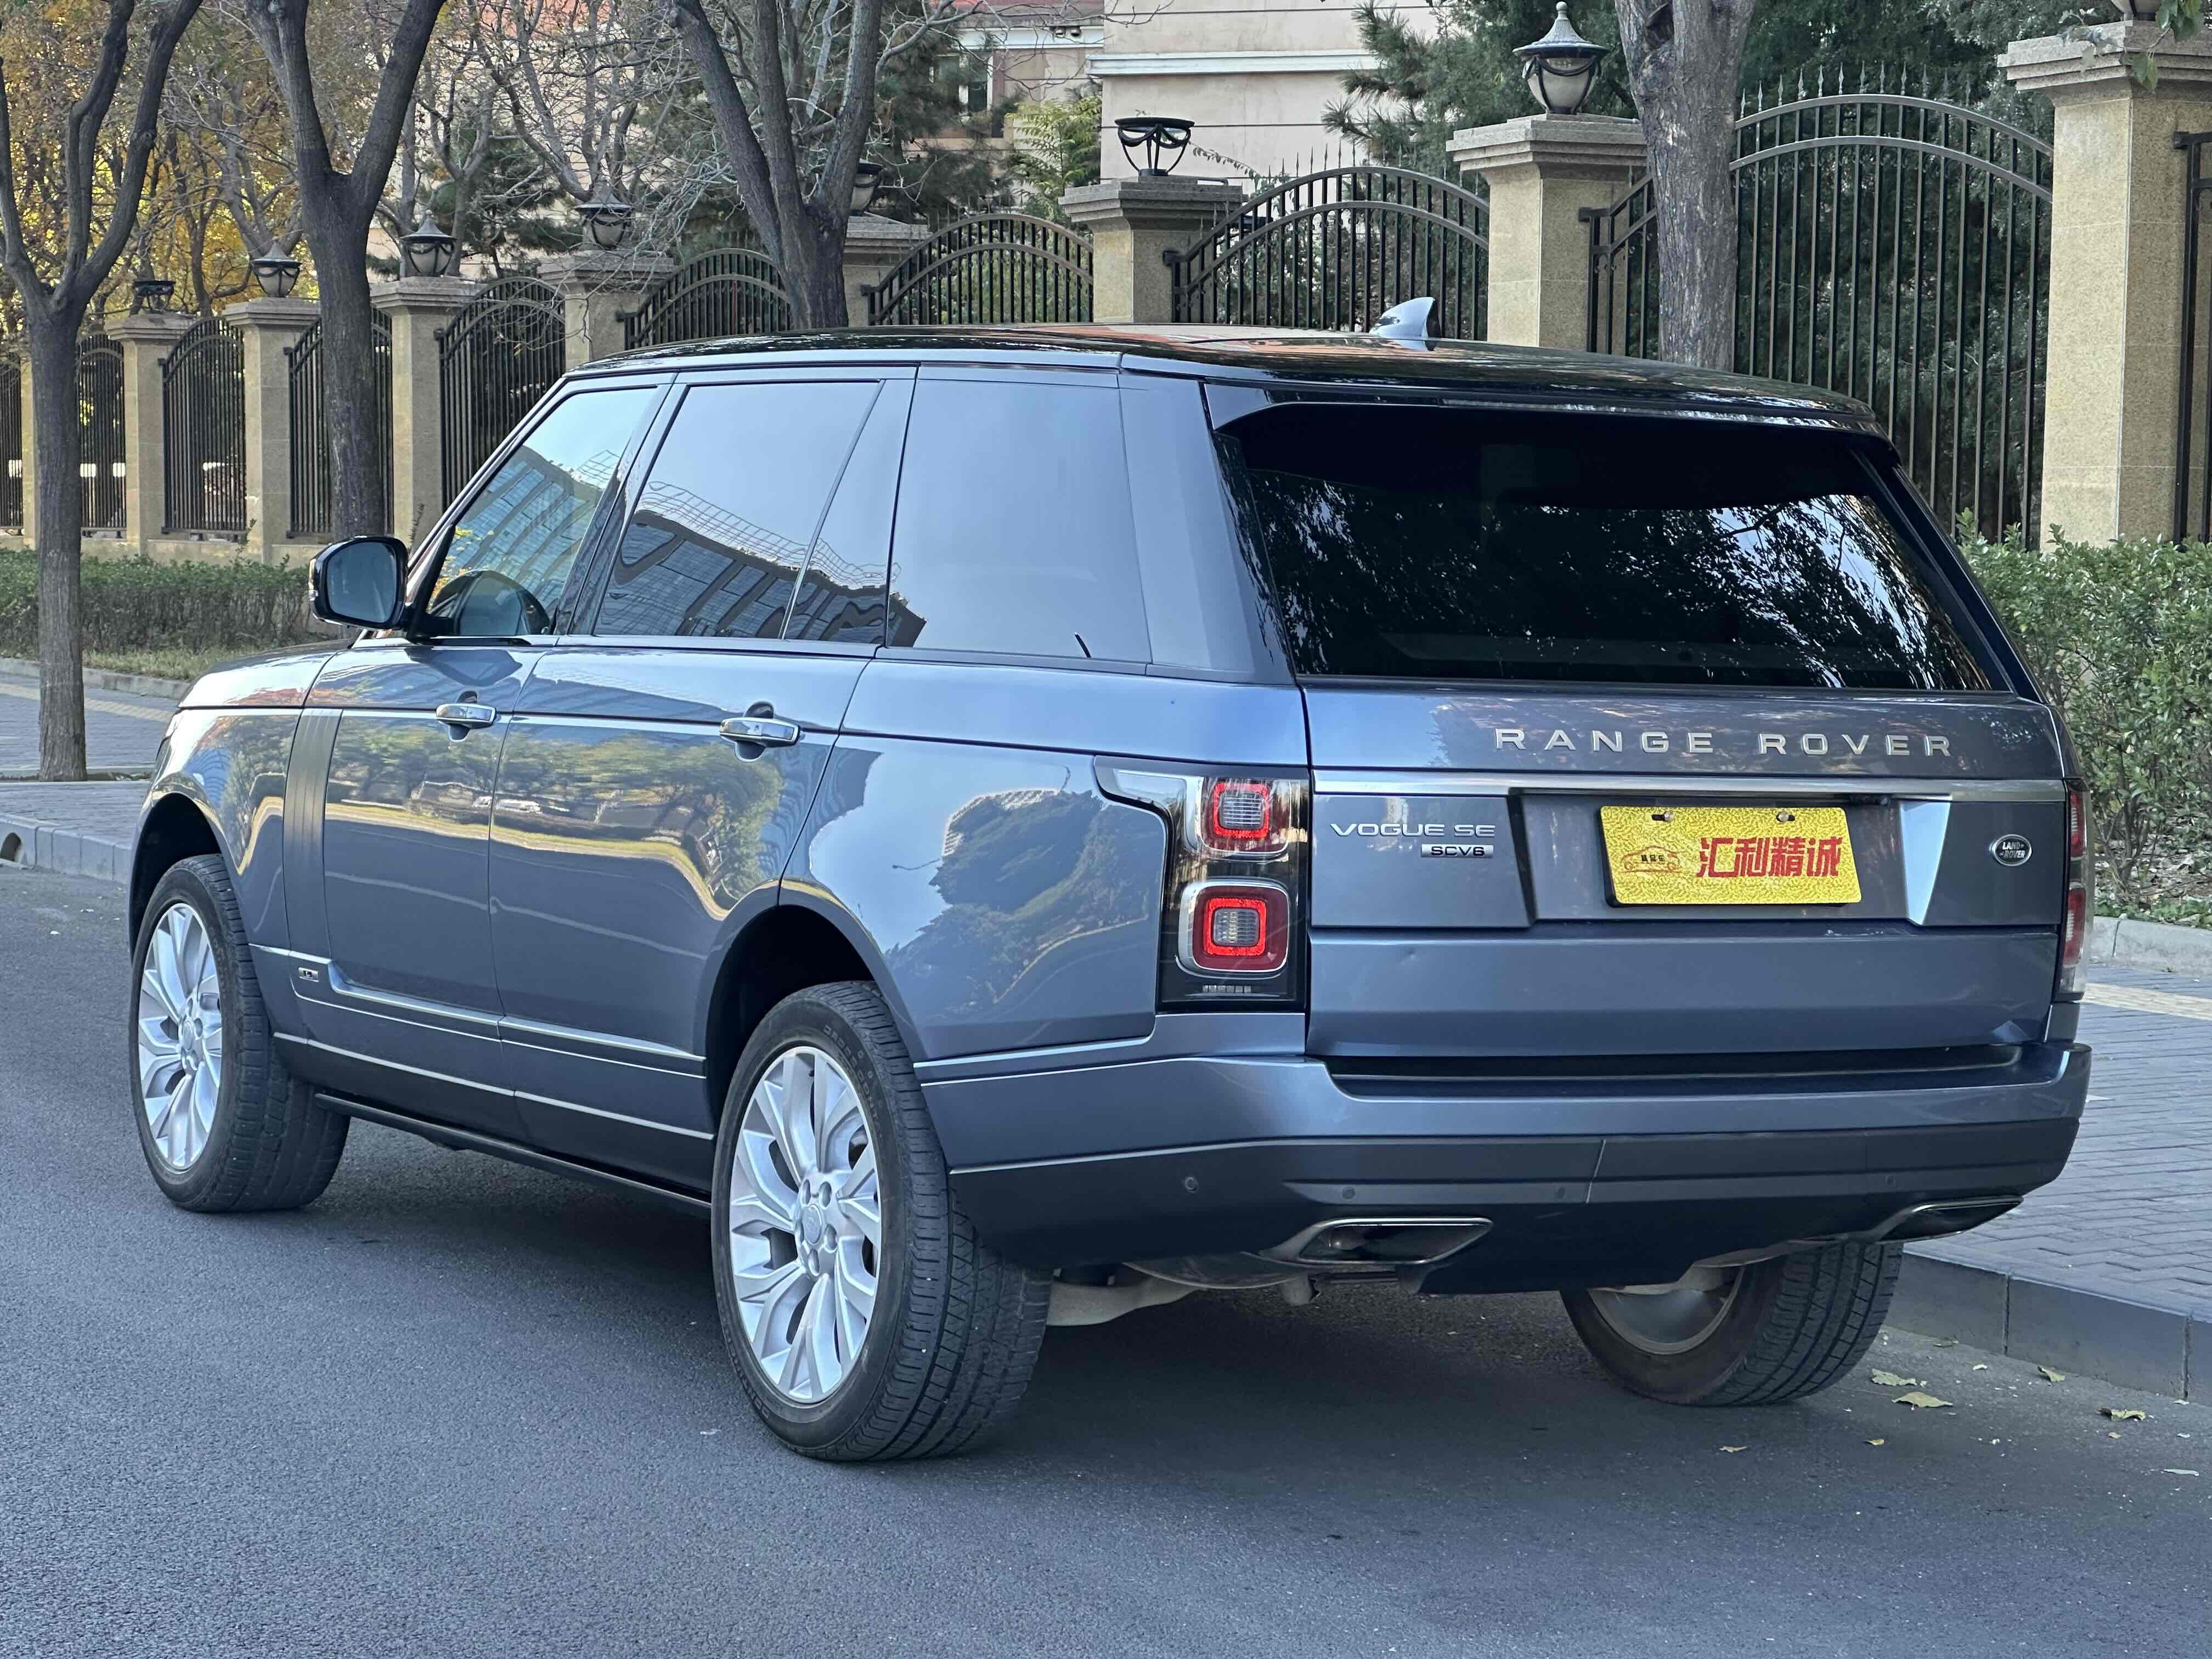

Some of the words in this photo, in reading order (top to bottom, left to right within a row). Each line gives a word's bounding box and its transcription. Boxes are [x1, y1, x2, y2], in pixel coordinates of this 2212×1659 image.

[1494, 728, 1714, 754] RANGE
[1758, 733, 1951, 757] ROVER
[1330, 823, 1445, 837] VOGUE
[1454, 824, 1496, 837] SE
[1430, 846, 1485, 856] SCV6
[2002, 841, 2021, 850] LAND
[1695, 836, 1844, 878] 汇利精诚
[2004, 850, 2026, 859] ROVER
